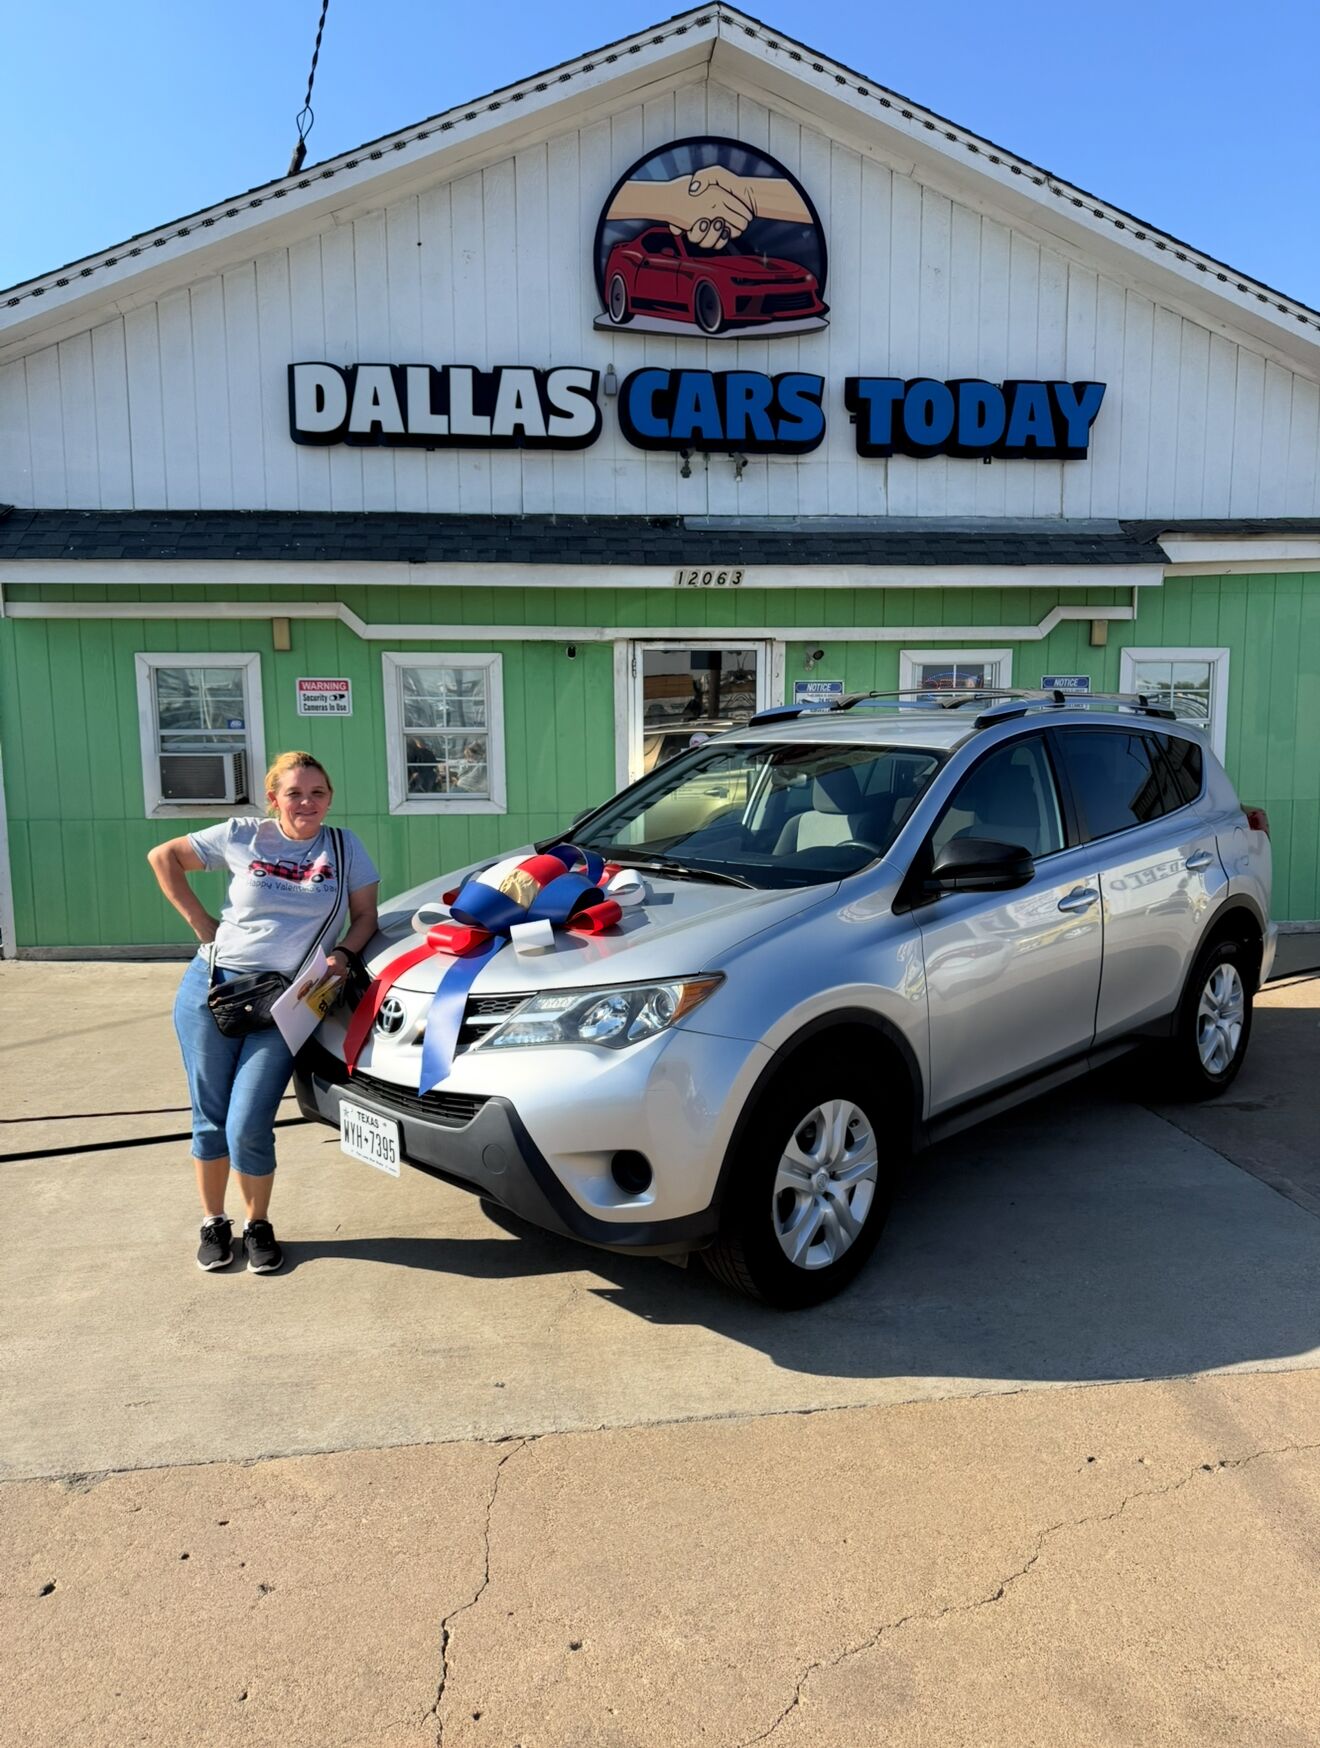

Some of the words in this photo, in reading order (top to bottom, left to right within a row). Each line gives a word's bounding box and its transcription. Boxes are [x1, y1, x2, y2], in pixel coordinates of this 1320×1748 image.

[292, 363, 598, 443] DALLAS
[626, 370, 824, 446] CARS
[856, 380, 1105, 451] TODAY
[678, 571, 742, 585] 12063
[301, 681, 347, 690] WARNING
[806, 683, 832, 691] NOTICE
[1053, 678, 1079, 687] NOTICE
[303, 693, 328, 703] Security
[303, 703, 328, 711] Cameras
[336, 703, 347, 711] Use
[357, 1111, 379, 1129] TEXAS
